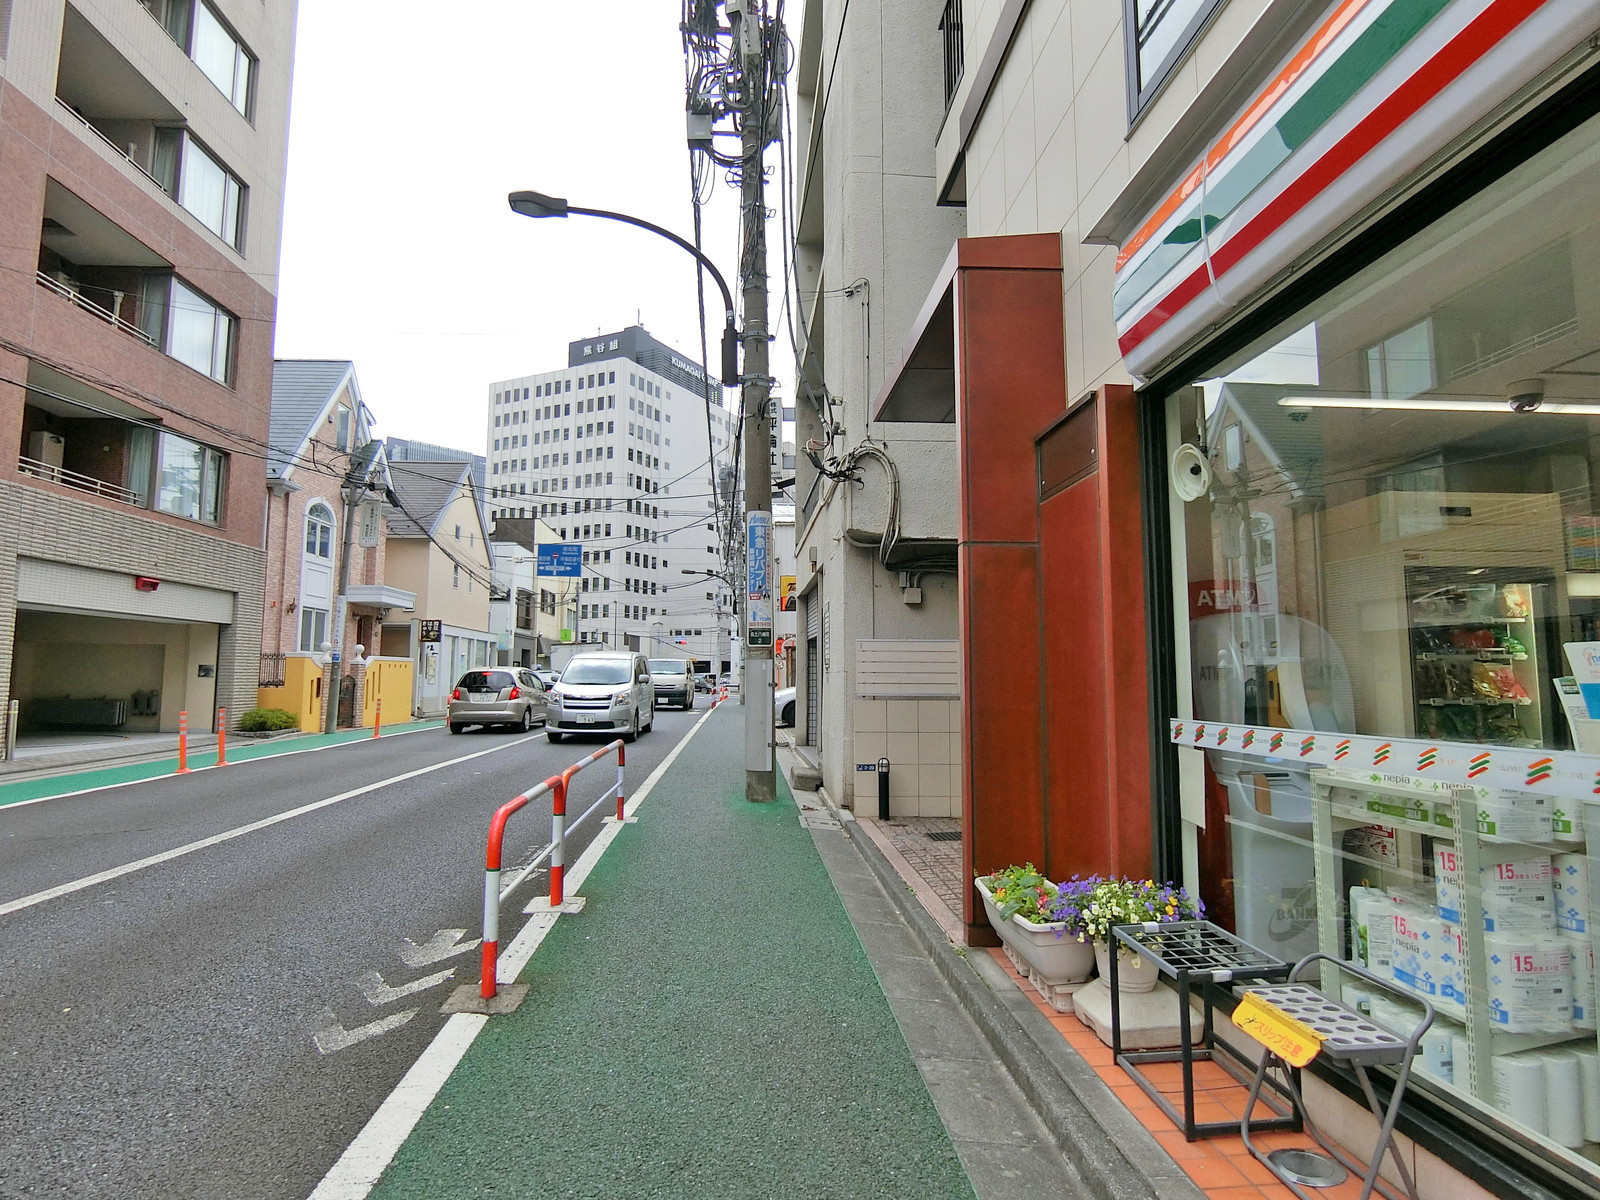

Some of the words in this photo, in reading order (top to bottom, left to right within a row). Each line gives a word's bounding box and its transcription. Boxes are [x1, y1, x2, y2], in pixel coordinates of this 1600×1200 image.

[583, 339, 619, 356] 熊谷組
[755, 526, 765, 591] 東急リバブル
[1383, 774, 1411, 785] nepia
[1497, 863, 1515, 880] 1.5
[1395, 938, 1420, 954] nepia
[1514, 954, 1534, 973] 1.5
[1254, 1022, 1304, 1058] スリップ注意
